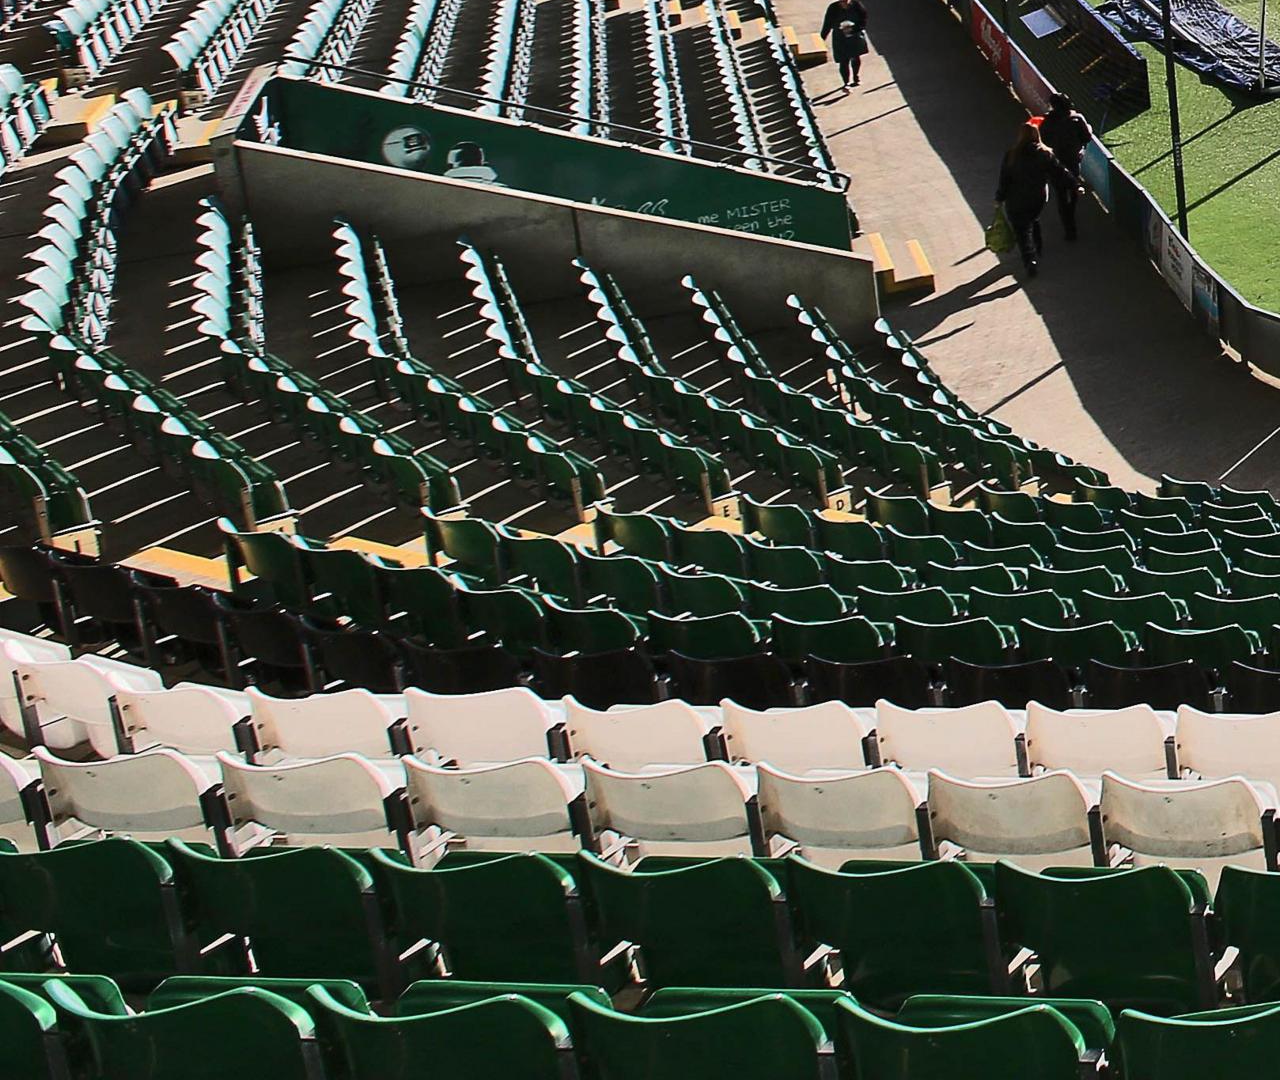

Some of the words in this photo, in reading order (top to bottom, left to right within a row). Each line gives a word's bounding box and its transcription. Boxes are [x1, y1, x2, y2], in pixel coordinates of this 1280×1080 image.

[697, 213, 720, 224] me
[726, 198, 791, 220] MISTER
[768, 214, 793, 229] the
